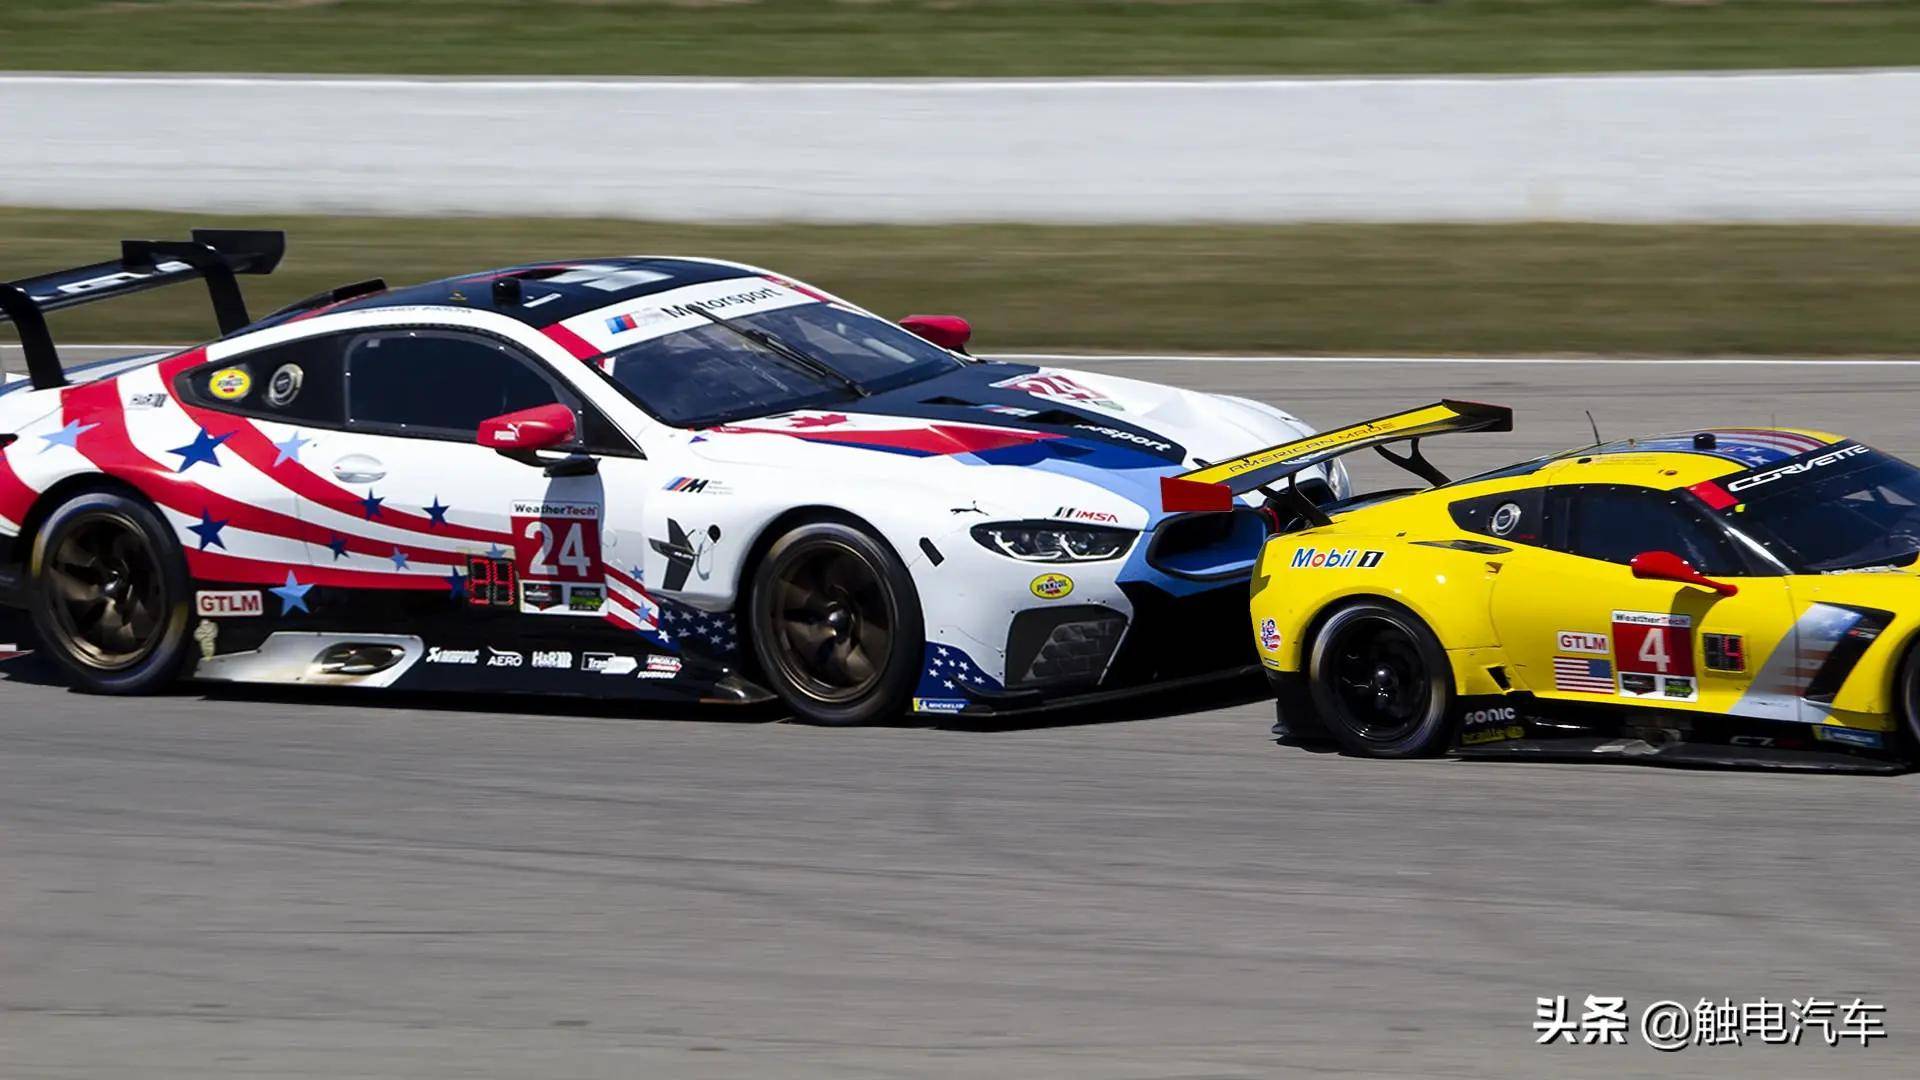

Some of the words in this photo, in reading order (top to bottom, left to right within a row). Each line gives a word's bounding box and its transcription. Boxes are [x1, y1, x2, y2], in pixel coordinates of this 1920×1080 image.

[660, 287, 782, 318] Motorsport
[1230, 439, 1334, 473] AMERICAN
[1338, 423, 1395, 441] MADE
[1728, 444, 1870, 492] CORVETTE
[514, 504, 597, 516] WeatherTech
[1075, 510, 1119, 524] IMSA
[525, 521, 591, 577] 24
[1291, 548, 1358, 568] Mobil
[1361, 551, 1380, 567] 1
[200, 595, 260, 612] GTLM
[1615, 613, 1689, 626] WeatherTech
[1560, 634, 1607, 651] GTLM
[1638, 627, 1671, 673] 4
[486, 655, 523, 667] AERO
[1464, 706, 1516, 725] sonic
